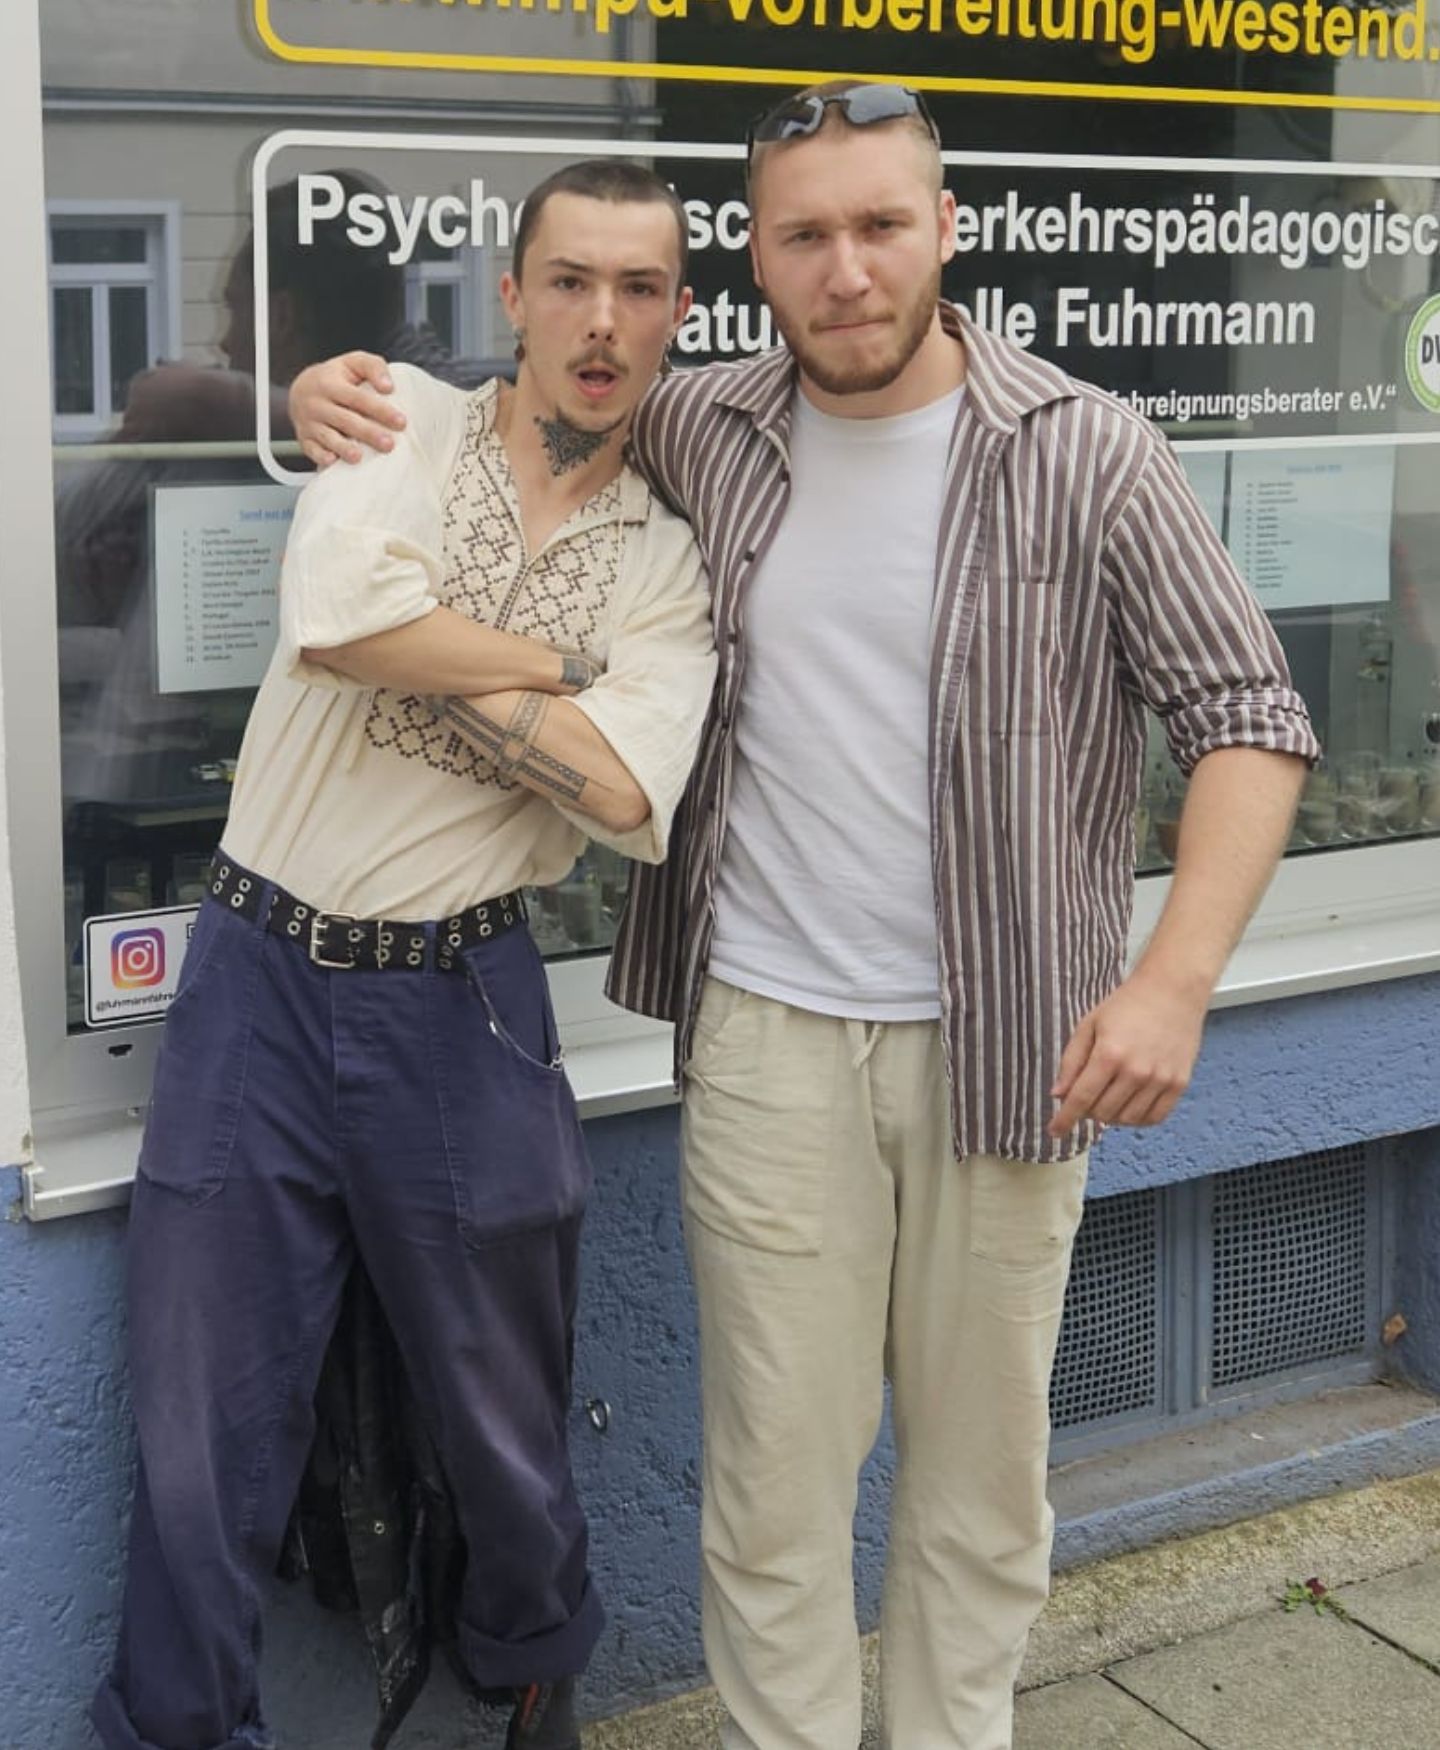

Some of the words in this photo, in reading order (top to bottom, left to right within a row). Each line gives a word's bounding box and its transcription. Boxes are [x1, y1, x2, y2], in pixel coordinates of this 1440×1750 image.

[943, 189, 1440, 269] erkehrspädagogisc
[1055, 286, 1316, 347] Fuhrmann
[1108, 386, 1343, 422] hreignungsberater
